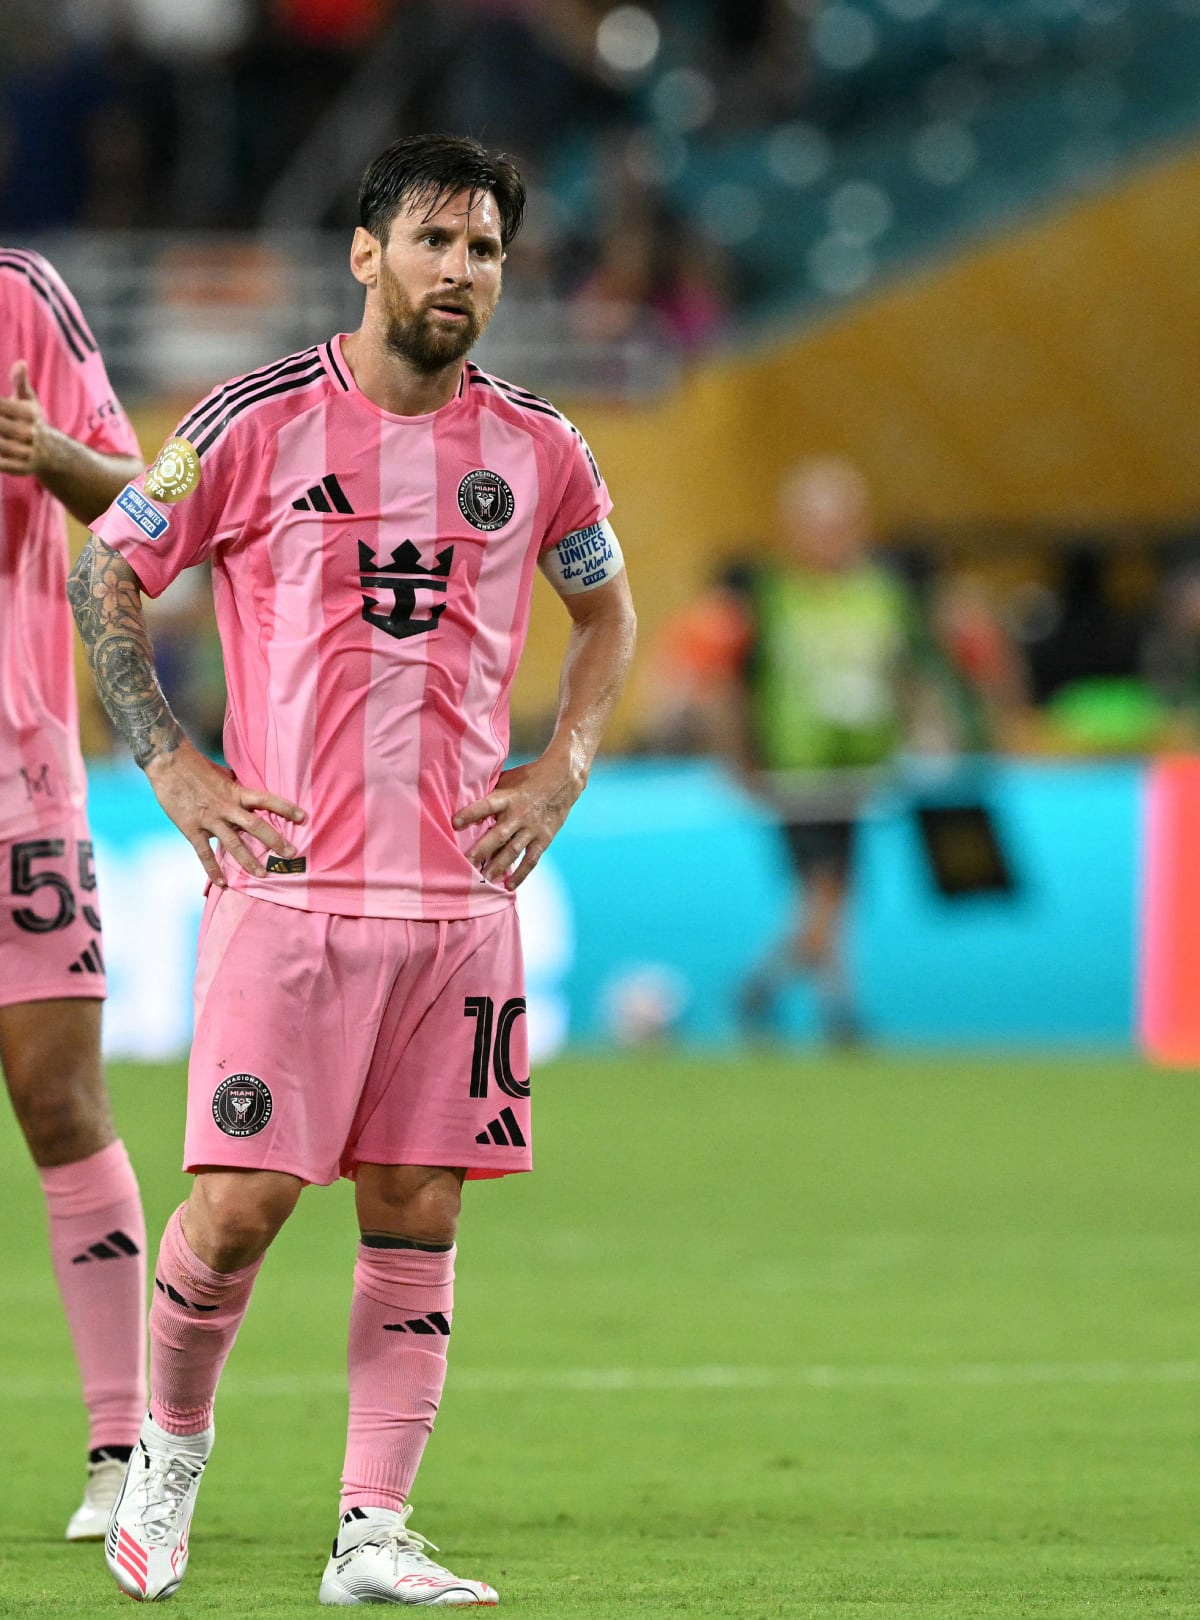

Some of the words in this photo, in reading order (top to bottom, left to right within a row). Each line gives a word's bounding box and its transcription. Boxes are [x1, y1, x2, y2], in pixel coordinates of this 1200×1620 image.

[185, 452, 195, 469] CUP
[186, 472, 194, 483] 25
[171, 483, 188, 495] USA
[142, 518, 154, 531] FIFA
[556, 522, 601, 551] FOOTBALL
[559, 531, 607, 565] UNITES
[560, 566, 583, 579] the
[583, 544, 614, 573] World
[584, 570, 606, 584] FIFA
[464, 996, 530, 1099] 10
[214, 1075, 262, 1102] INTERNACIONAL
[262, 1088, 269, 1097] DE
